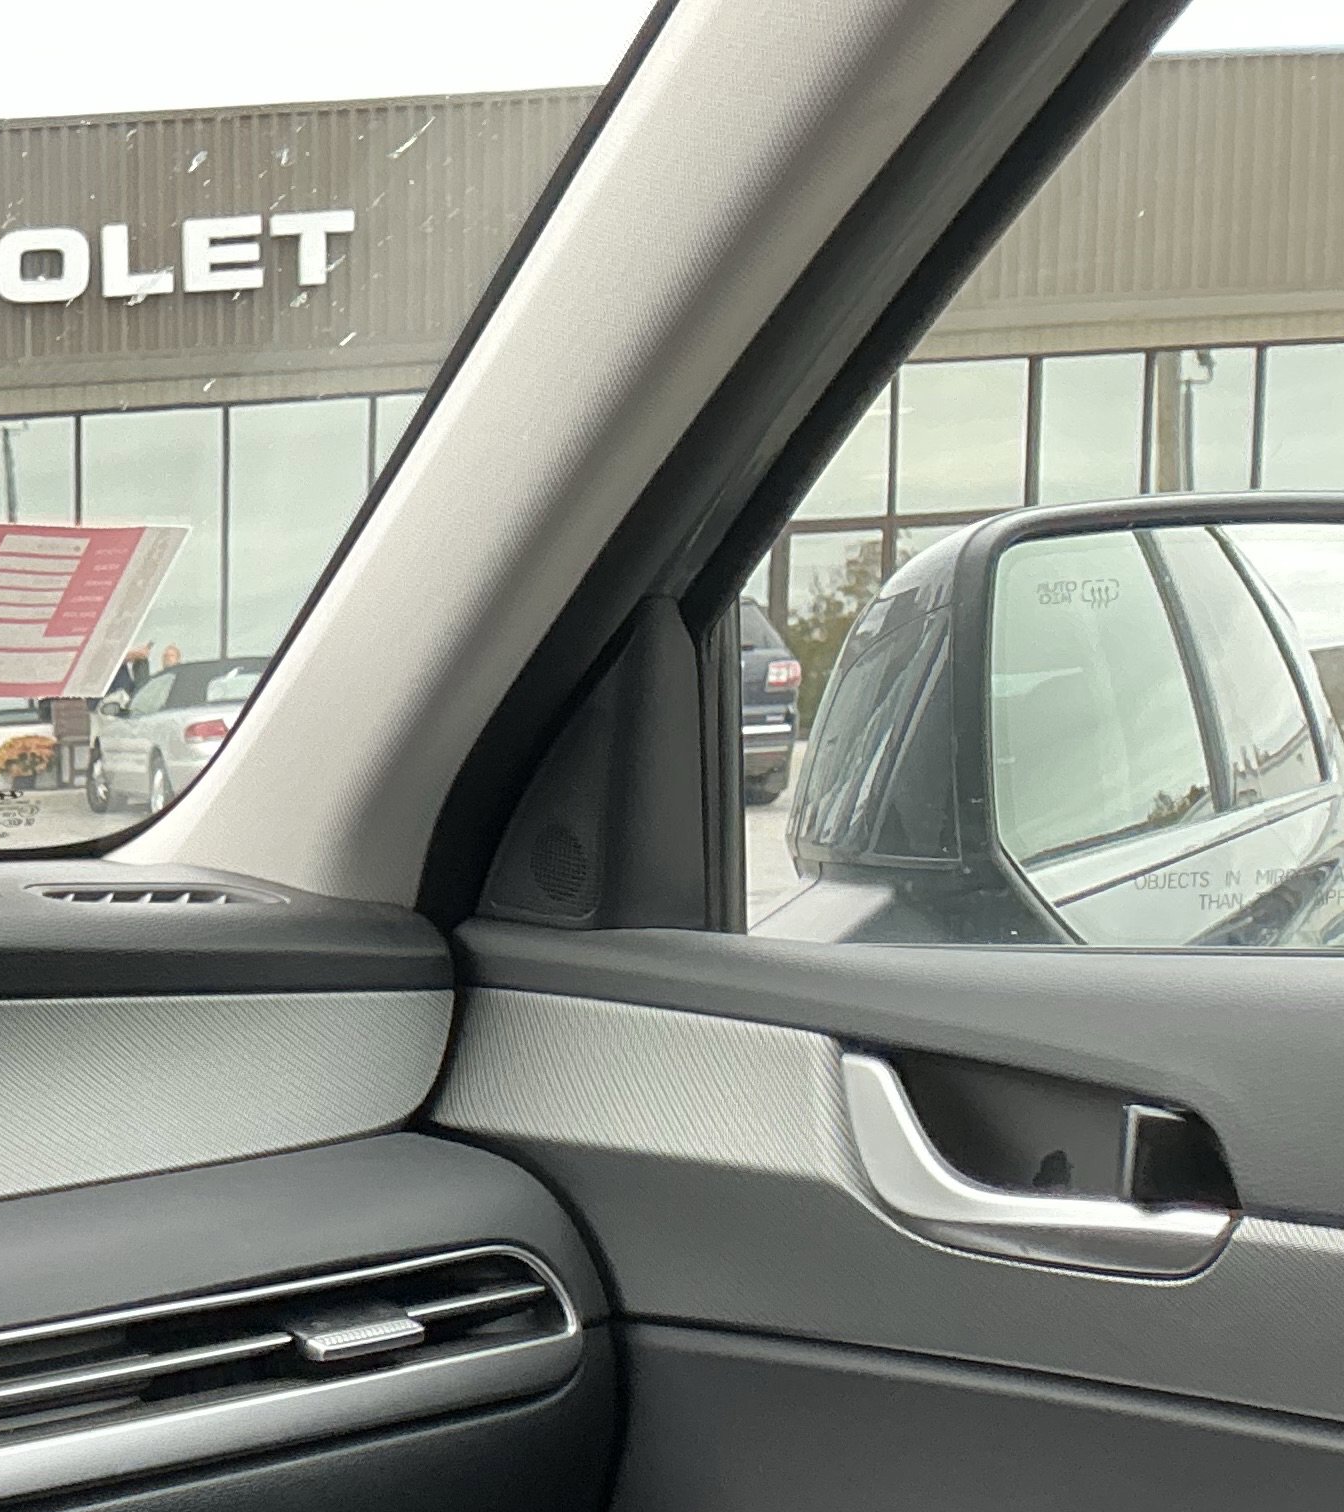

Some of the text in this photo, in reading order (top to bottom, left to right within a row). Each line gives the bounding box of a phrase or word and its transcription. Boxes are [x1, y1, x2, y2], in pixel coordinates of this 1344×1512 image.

[1135, 871, 1209, 890] OBJECTS
[1225, 869, 1240, 887] IN
[1199, 893, 1243, 911] THAN
